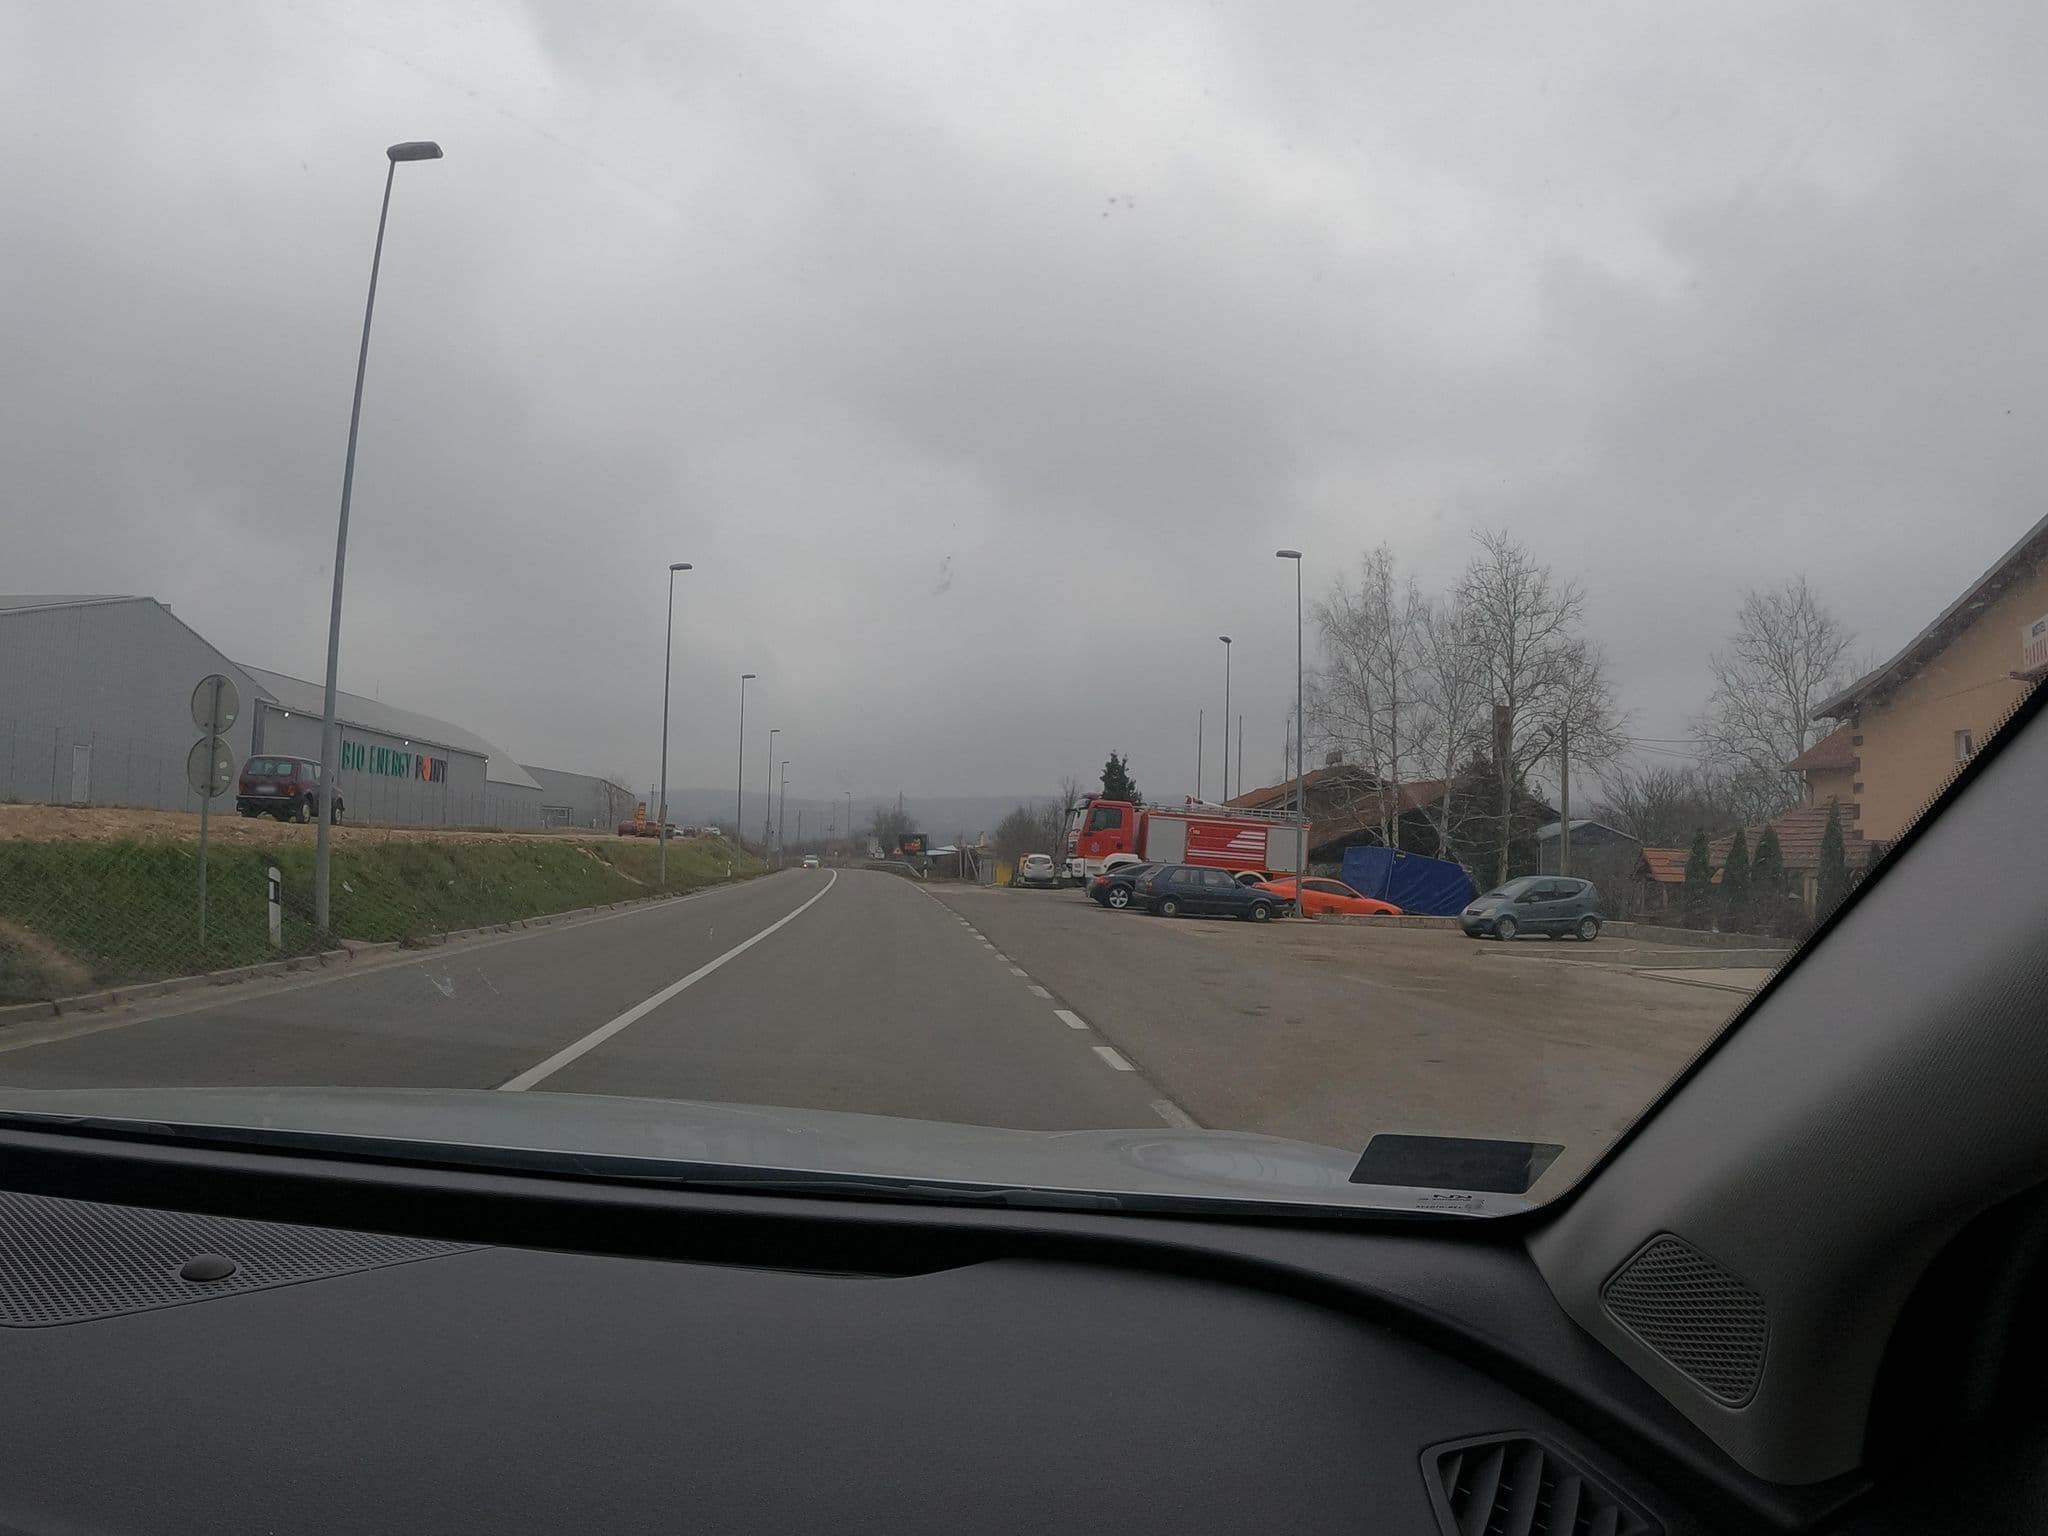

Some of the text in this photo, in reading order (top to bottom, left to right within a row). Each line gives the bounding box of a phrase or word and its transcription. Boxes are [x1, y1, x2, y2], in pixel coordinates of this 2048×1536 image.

[341, 740, 448, 784] BIO ENERGY POINT
